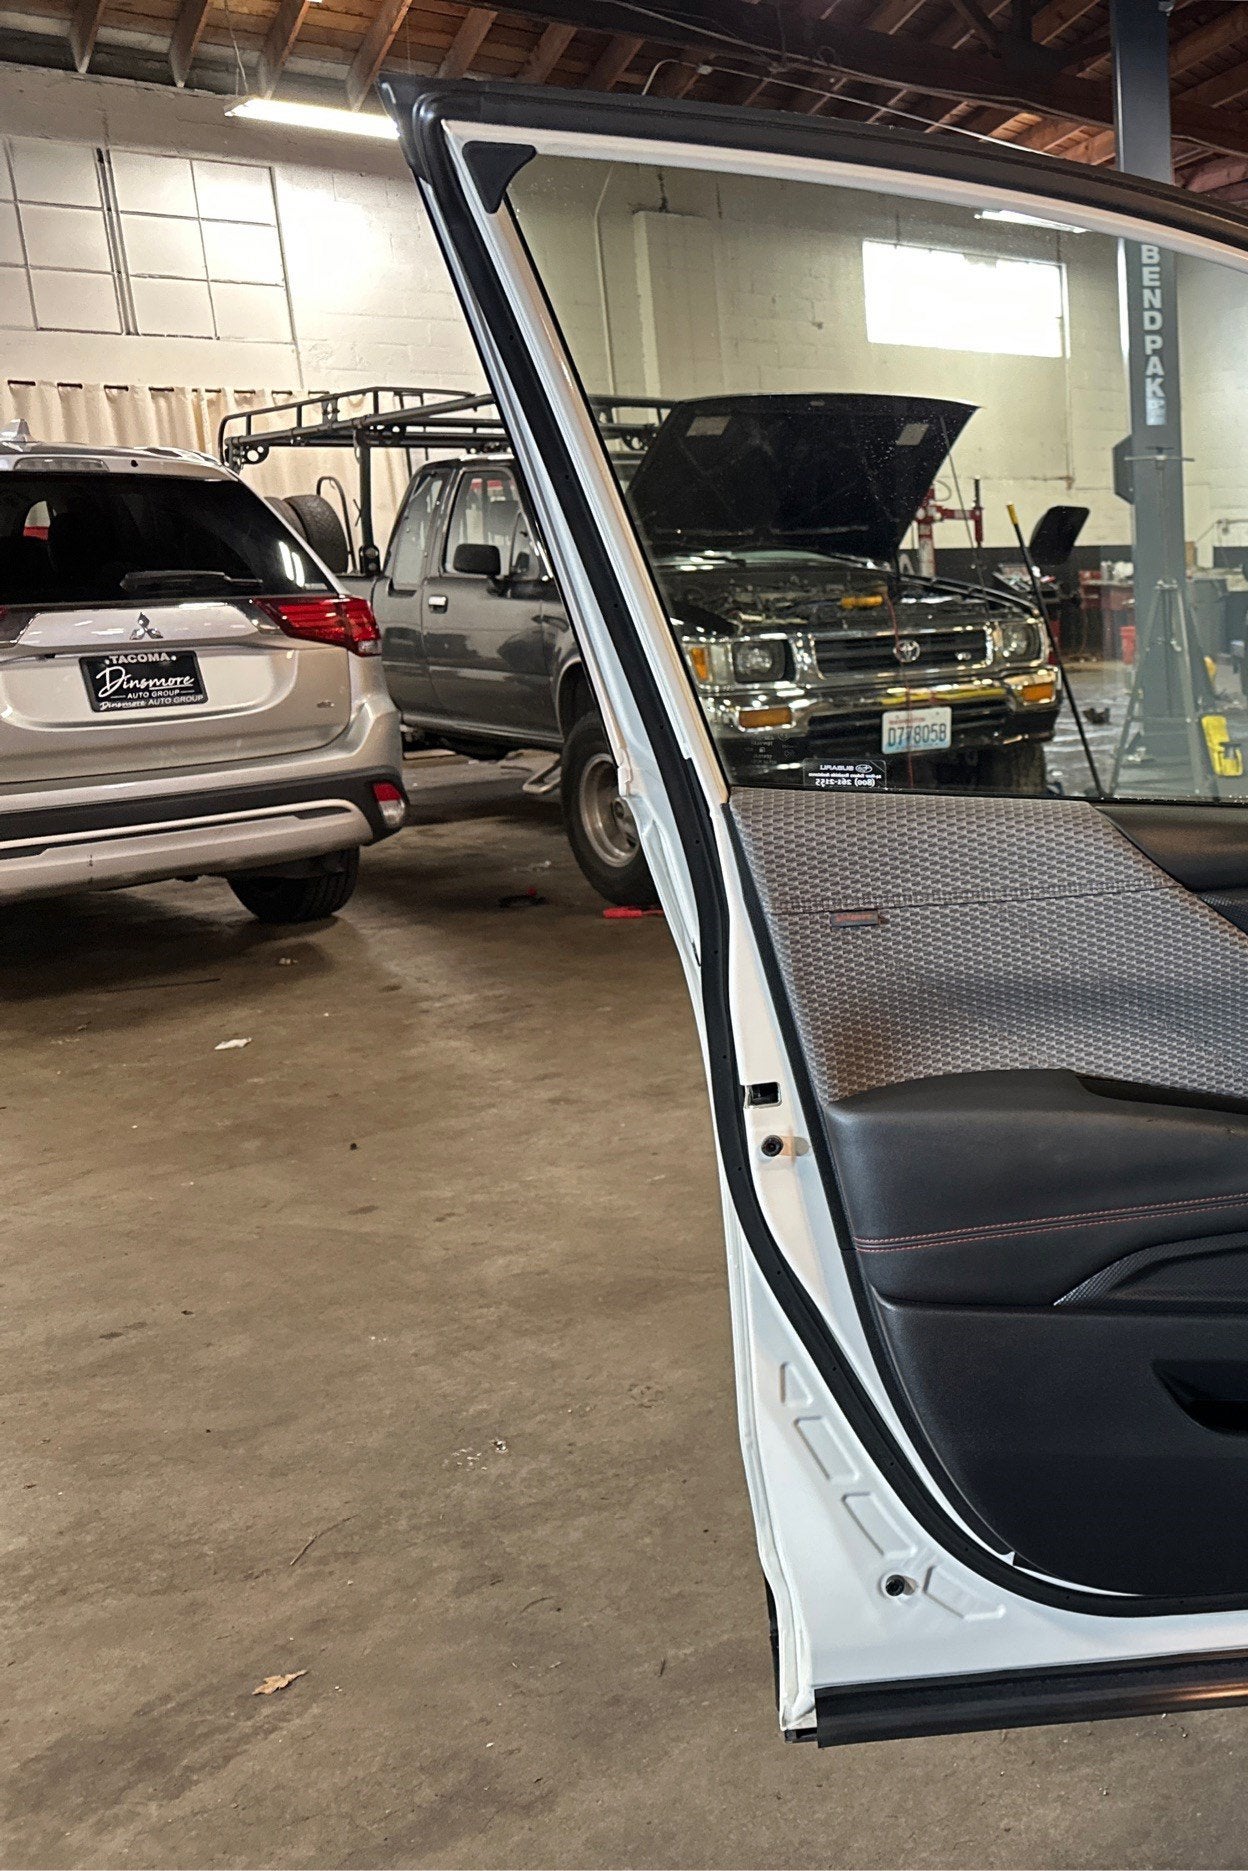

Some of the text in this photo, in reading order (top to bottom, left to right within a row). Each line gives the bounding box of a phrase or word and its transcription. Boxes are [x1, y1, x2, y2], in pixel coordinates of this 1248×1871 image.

[1141, 245, 1165, 397] BENDPAK
[109, 653, 170, 664] TACOMA
[95, 666, 194, 697] Dinsmore
[127, 689, 180, 699] AUTO GROUP
[148, 698, 171, 706] AUTO
[173, 695, 204, 704] GROUP
